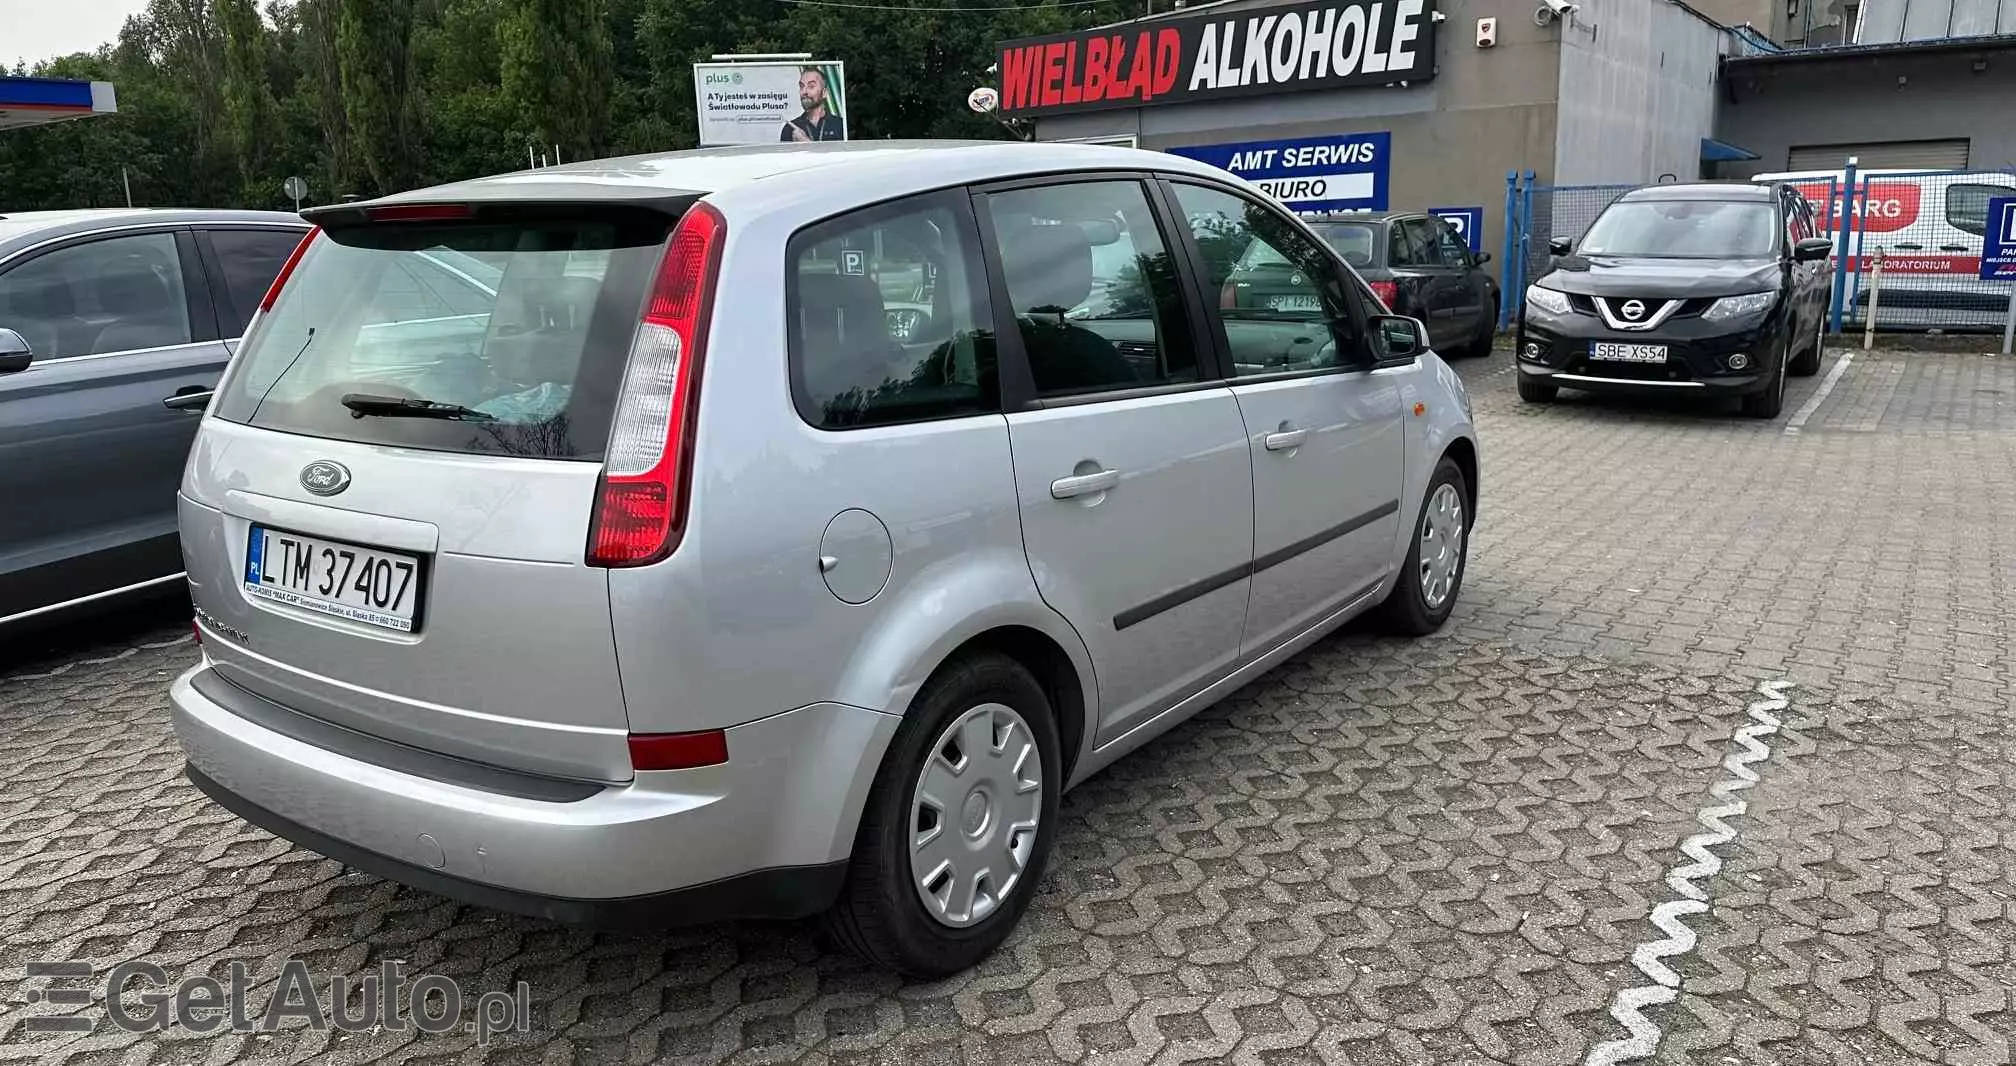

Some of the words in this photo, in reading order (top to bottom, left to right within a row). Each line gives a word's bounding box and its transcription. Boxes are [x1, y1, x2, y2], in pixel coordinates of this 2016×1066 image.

[1002, 28, 1181, 109] WIELBŁĄD
[1188, 0, 1425, 91] ALKOHOLE
[705, 73, 729, 84] plus
[714, 93, 723, 102] Ty
[723, 92, 748, 101] jesteś
[757, 92, 788, 102] zasięgu
[1227, 150, 1278, 171] AMT
[1282, 143, 1375, 168] SERWIS
[1861, 260, 1951, 271] LAORATORIUM
[1598, 344, 1628, 358] SBE
[1631, 345, 1666, 360] XS54
[250, 562, 260, 575] PL
[261, 535, 313, 591] LTM
[318, 548, 414, 611] 37407
